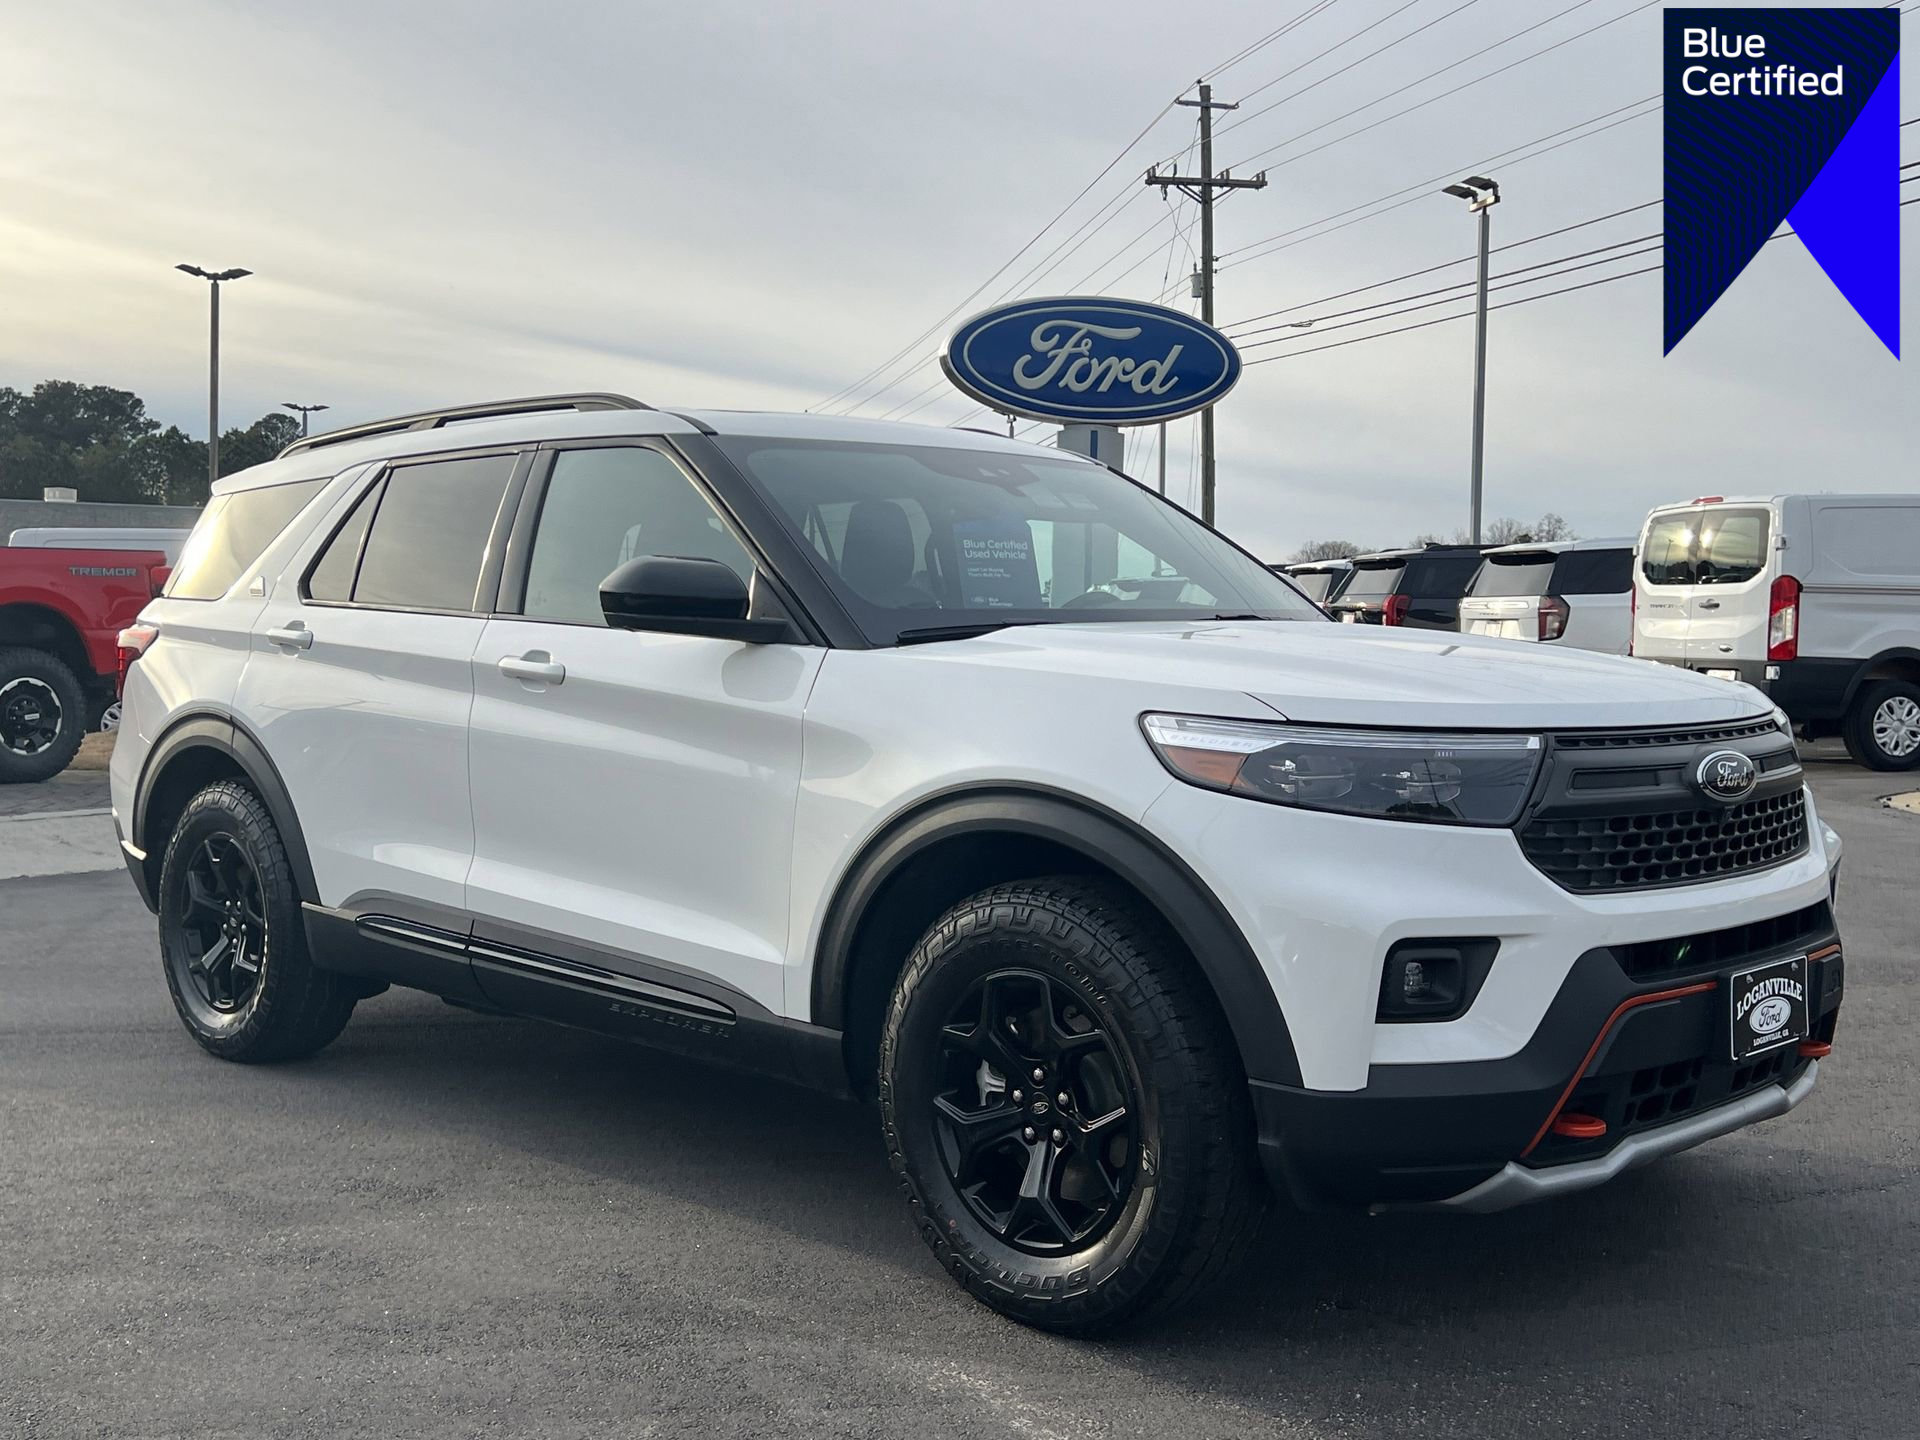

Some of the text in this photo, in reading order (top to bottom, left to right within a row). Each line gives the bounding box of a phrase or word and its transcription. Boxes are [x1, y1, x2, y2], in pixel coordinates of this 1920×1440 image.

[1012, 319, 1184, 395] Ford
[963, 539, 1028, 551] Blue Certified
[964, 549, 1027, 560] Used Vehicle
[68, 567, 137, 577] TREMOR
[1717, 761, 1749, 787] Ford
[1736, 977, 1803, 1021] LOGANVILLE
[1758, 1004, 1783, 1028] Ford
